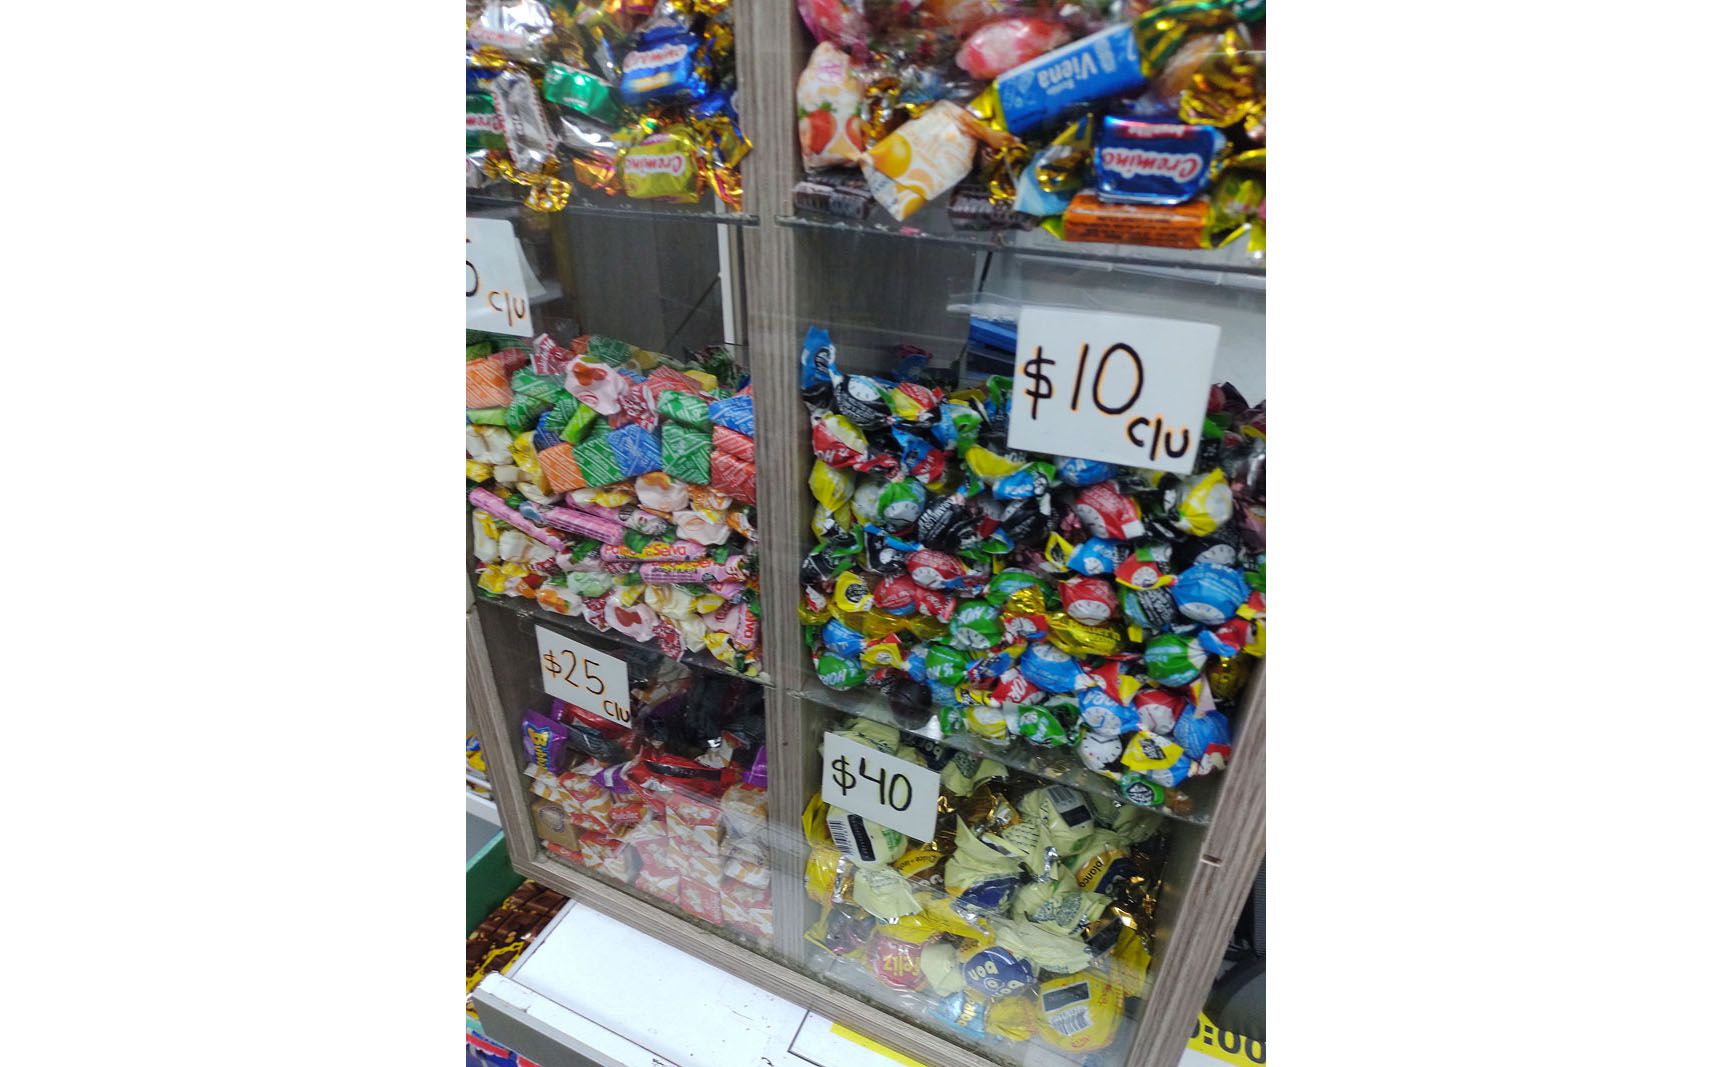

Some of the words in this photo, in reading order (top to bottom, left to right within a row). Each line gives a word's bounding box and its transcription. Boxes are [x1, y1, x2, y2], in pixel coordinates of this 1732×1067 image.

[1037, 51, 1098, 87] Viena
[1101, 151, 1201, 181] Cremino
[1024, 342, 1144, 419] $10
[542, 649, 606, 696] $25
[831, 754, 913, 812] $40
[1190, 1017, 1267, 1064] :00
